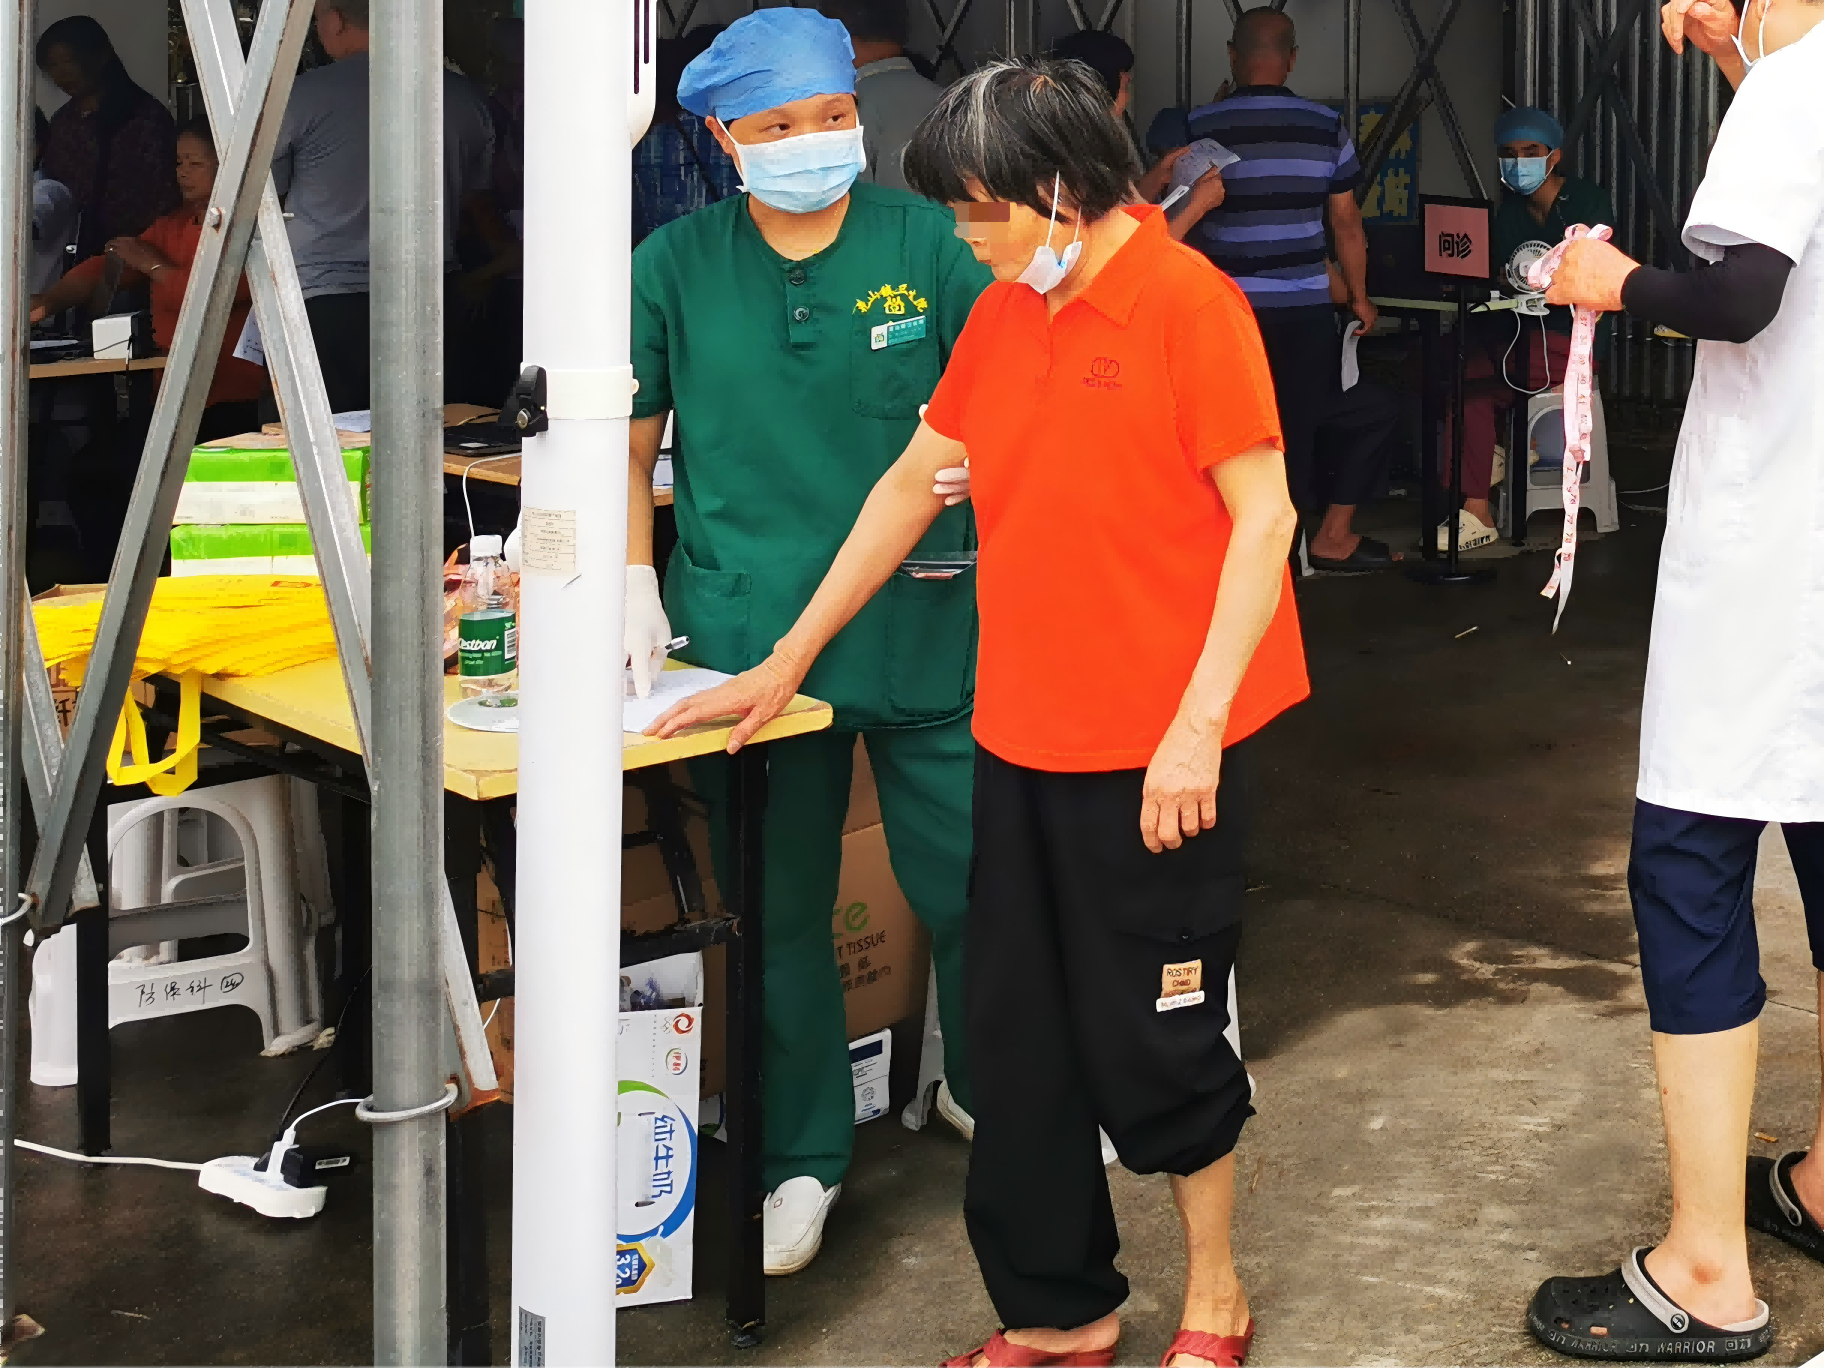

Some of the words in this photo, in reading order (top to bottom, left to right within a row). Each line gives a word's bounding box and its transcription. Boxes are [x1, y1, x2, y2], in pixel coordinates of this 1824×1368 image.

[1438, 231, 1473, 260] 问诊
[652, 1115, 675, 1199] 纯牛奶
